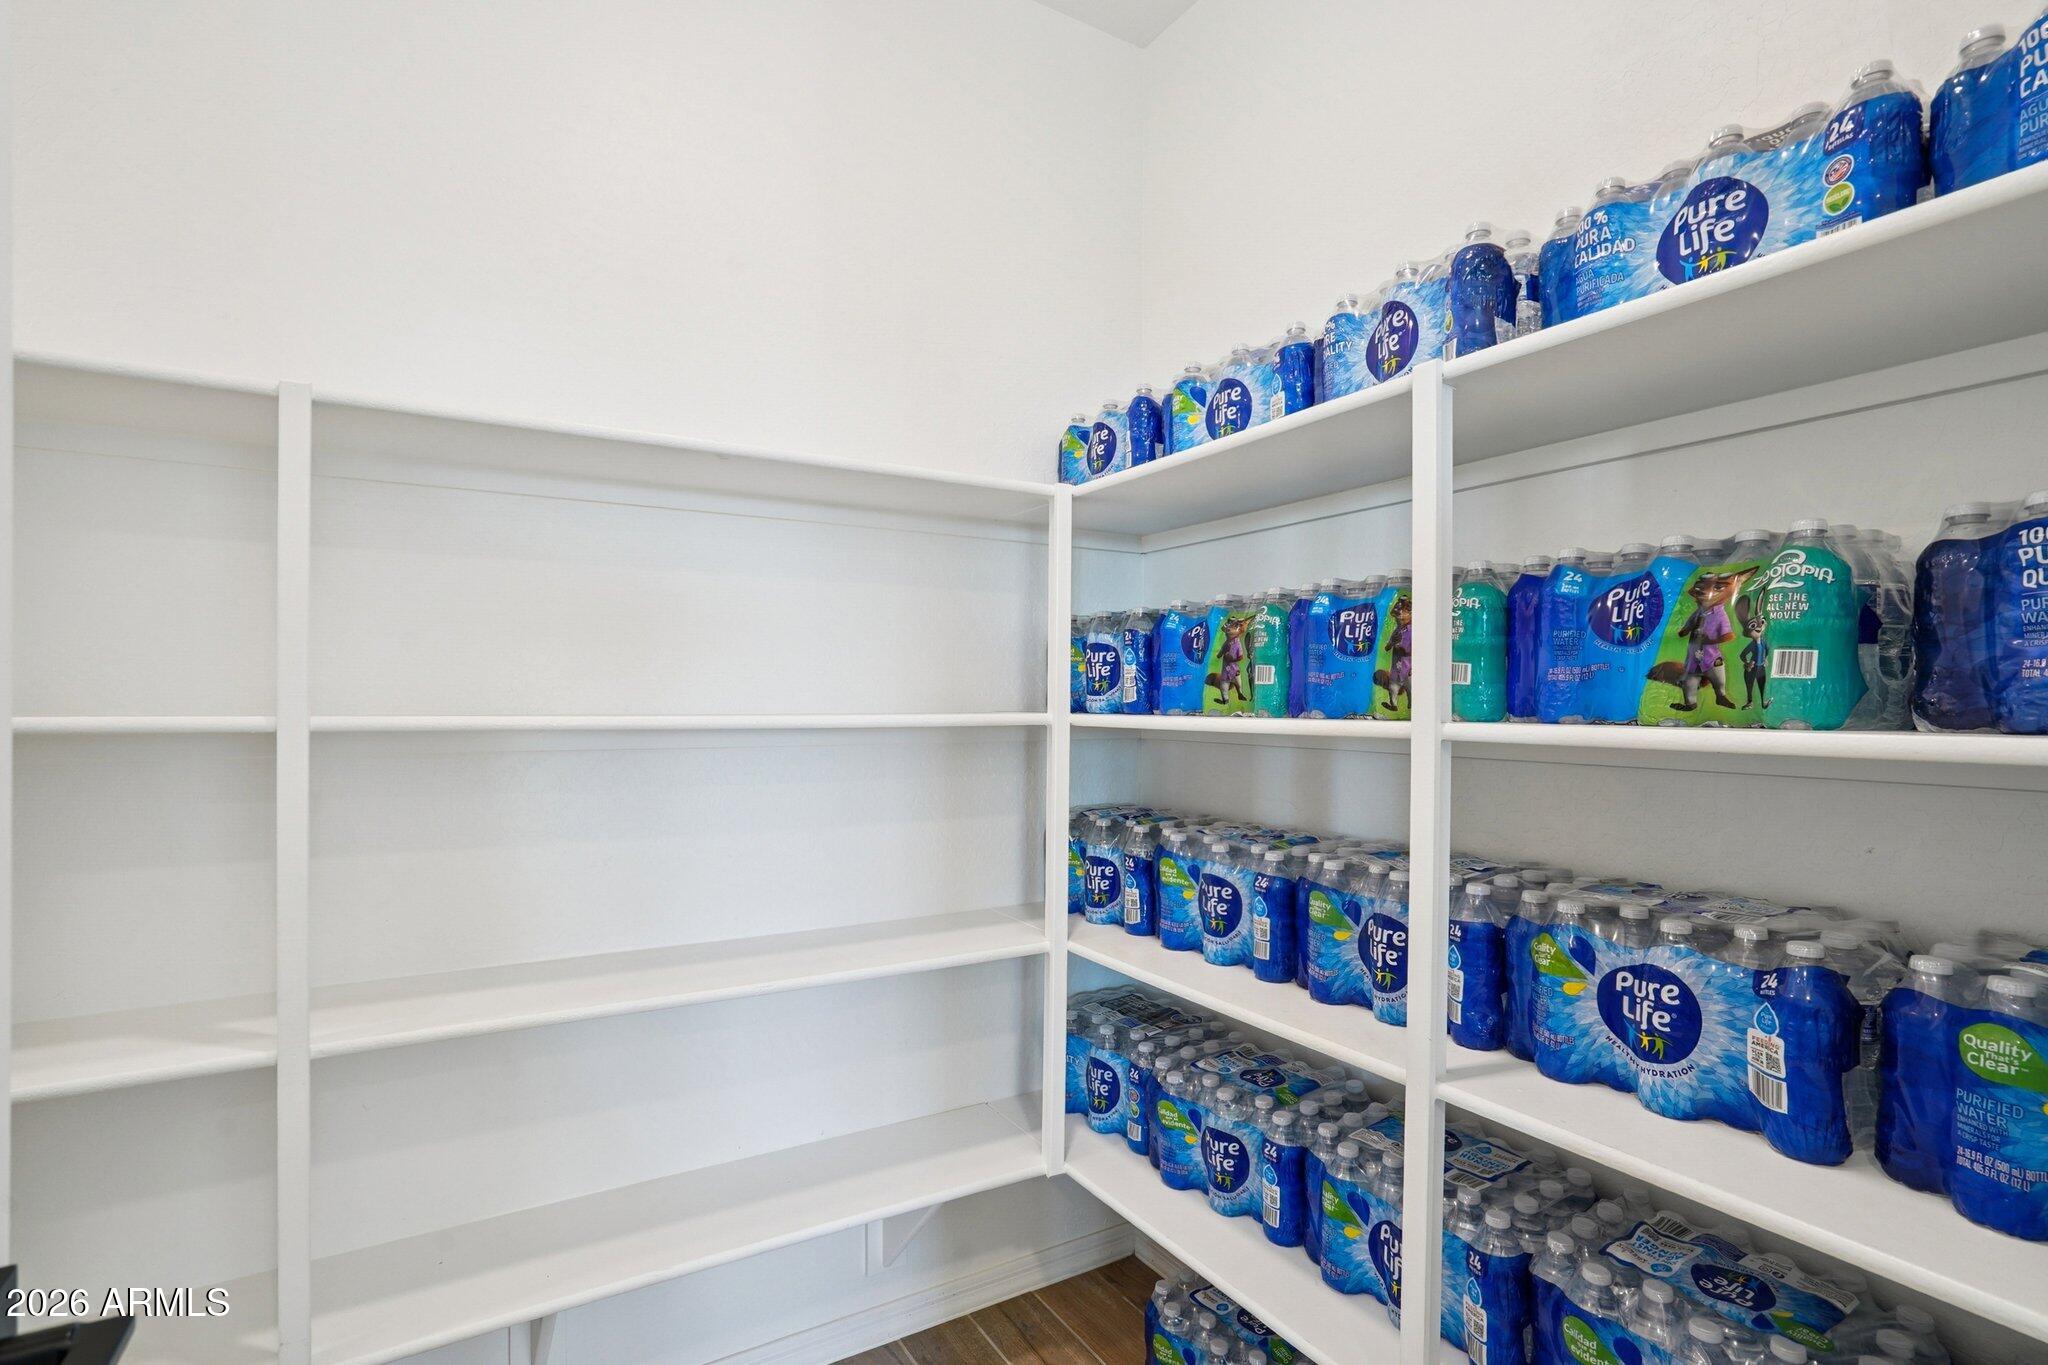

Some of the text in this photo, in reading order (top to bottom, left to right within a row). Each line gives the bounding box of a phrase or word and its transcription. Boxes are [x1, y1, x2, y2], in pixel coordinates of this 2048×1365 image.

[2021, 42, 2048, 78] PU
[2021, 97, 2048, 122] AGU
[1829, 109, 1854, 144] 24
[1674, 190, 1746, 235] Pure
[1679, 219, 1735, 256] Life
[1574, 238, 1636, 269] CALIDAD
[1324, 342, 1353, 358] ALITY
[1213, 386, 1242, 410] Pure
[1214, 403, 1237, 427] Life
[2019, 526, 2048, 546] 10
[2018, 546, 2048, 567] PU
[1563, 571, 1583, 583] 24
[1607, 580, 1650, 608] Pure
[1769, 592, 1808, 602] SEE THE
[1612, 599, 1645, 625] Life
[1767, 602, 1810, 612] ALL-NEW
[1770, 611, 1802, 620] MOVIE
[1345, 622, 1373, 642] Life
[1086, 648, 1116, 663] Pure
[1087, 662, 1111, 682] Life
[1085, 859, 1115, 877] Pure
[1087, 875, 1110, 893] Life
[1202, 897, 1228, 918] Life
[1368, 919, 1407, 947] Pure
[1450, 924, 1462, 938] 24
[1370, 938, 1398, 968] Life
[1615, 971, 1680, 1006] Pure
[1760, 972, 1778, 989] 24
[1622, 995, 1671, 1032] Life
[1605, 1035, 1696, 1079] HEALTHY HYDRATION
[1963, 1034, 2033, 1062] Quality
[1984, 1050, 2020, 1066] That's
[1129, 1067, 1140, 1080] 24
[1967, 1051, 2019, 1075] Clear
[1956, 1100, 2007, 1129] WATER
[1957, 1087, 2024, 1119] PURIFIED
[1206, 1146, 1235, 1171] Life
[1264, 1142, 1278, 1158] 24
[2025, 1170, 2048, 1184] BOTTL
[1381, 1224, 1402, 1254] Pu
[1384, 1245, 1402, 1280] Lif
[1469, 1250, 1482, 1270] 24
[1699, 1278, 1754, 1307] Pure
[1714, 1276, 1755, 1299] Life
[1564, 1323, 1598, 1350] Calidad
[1570, 1344, 1610, 1365] evident
